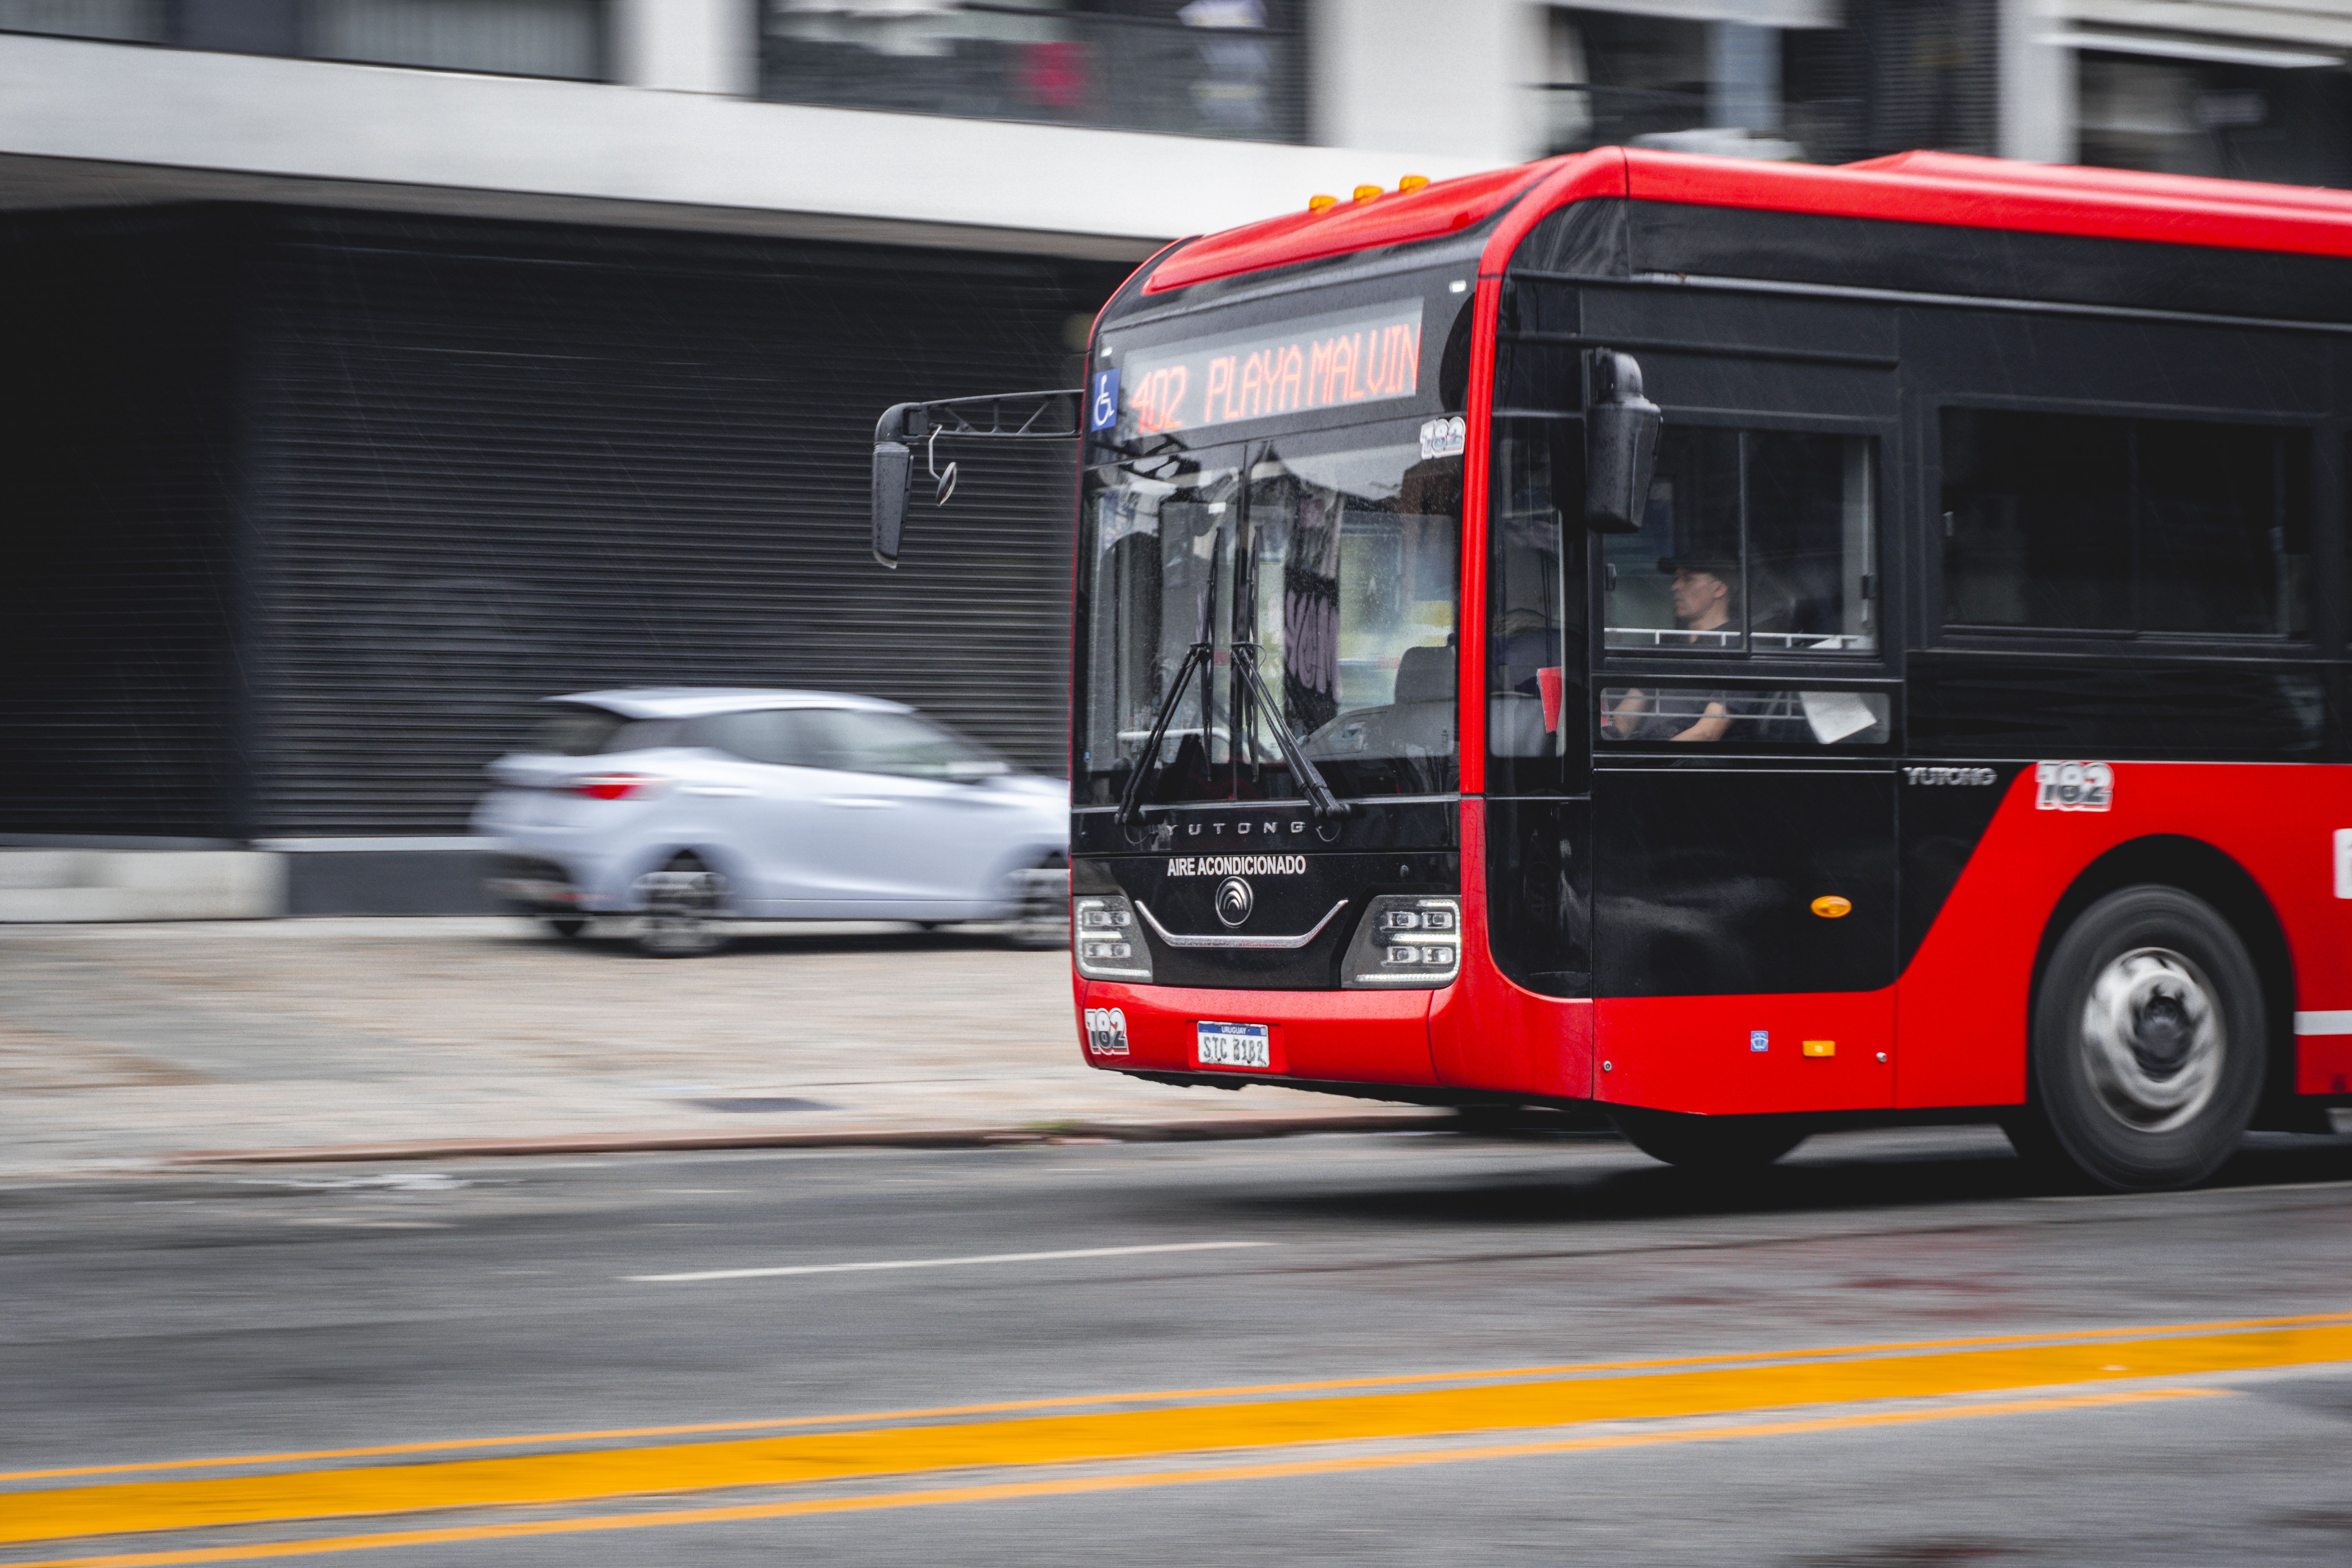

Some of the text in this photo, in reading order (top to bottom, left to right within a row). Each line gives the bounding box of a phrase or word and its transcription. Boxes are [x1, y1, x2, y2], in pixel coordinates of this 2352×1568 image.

[1131, 365, 1186, 434] 402
[1205, 344, 1303, 423] PLAYA
[1420, 416, 1465, 459] 182
[2036, 761, 2114, 812] 182
[1166, 822, 1305, 836] YUTONG
[1167, 855, 1306, 876] AIRE ACONDICIONADO
[1085, 1007, 1129, 1055] 182
[1204, 1036, 1227, 1059] STC
